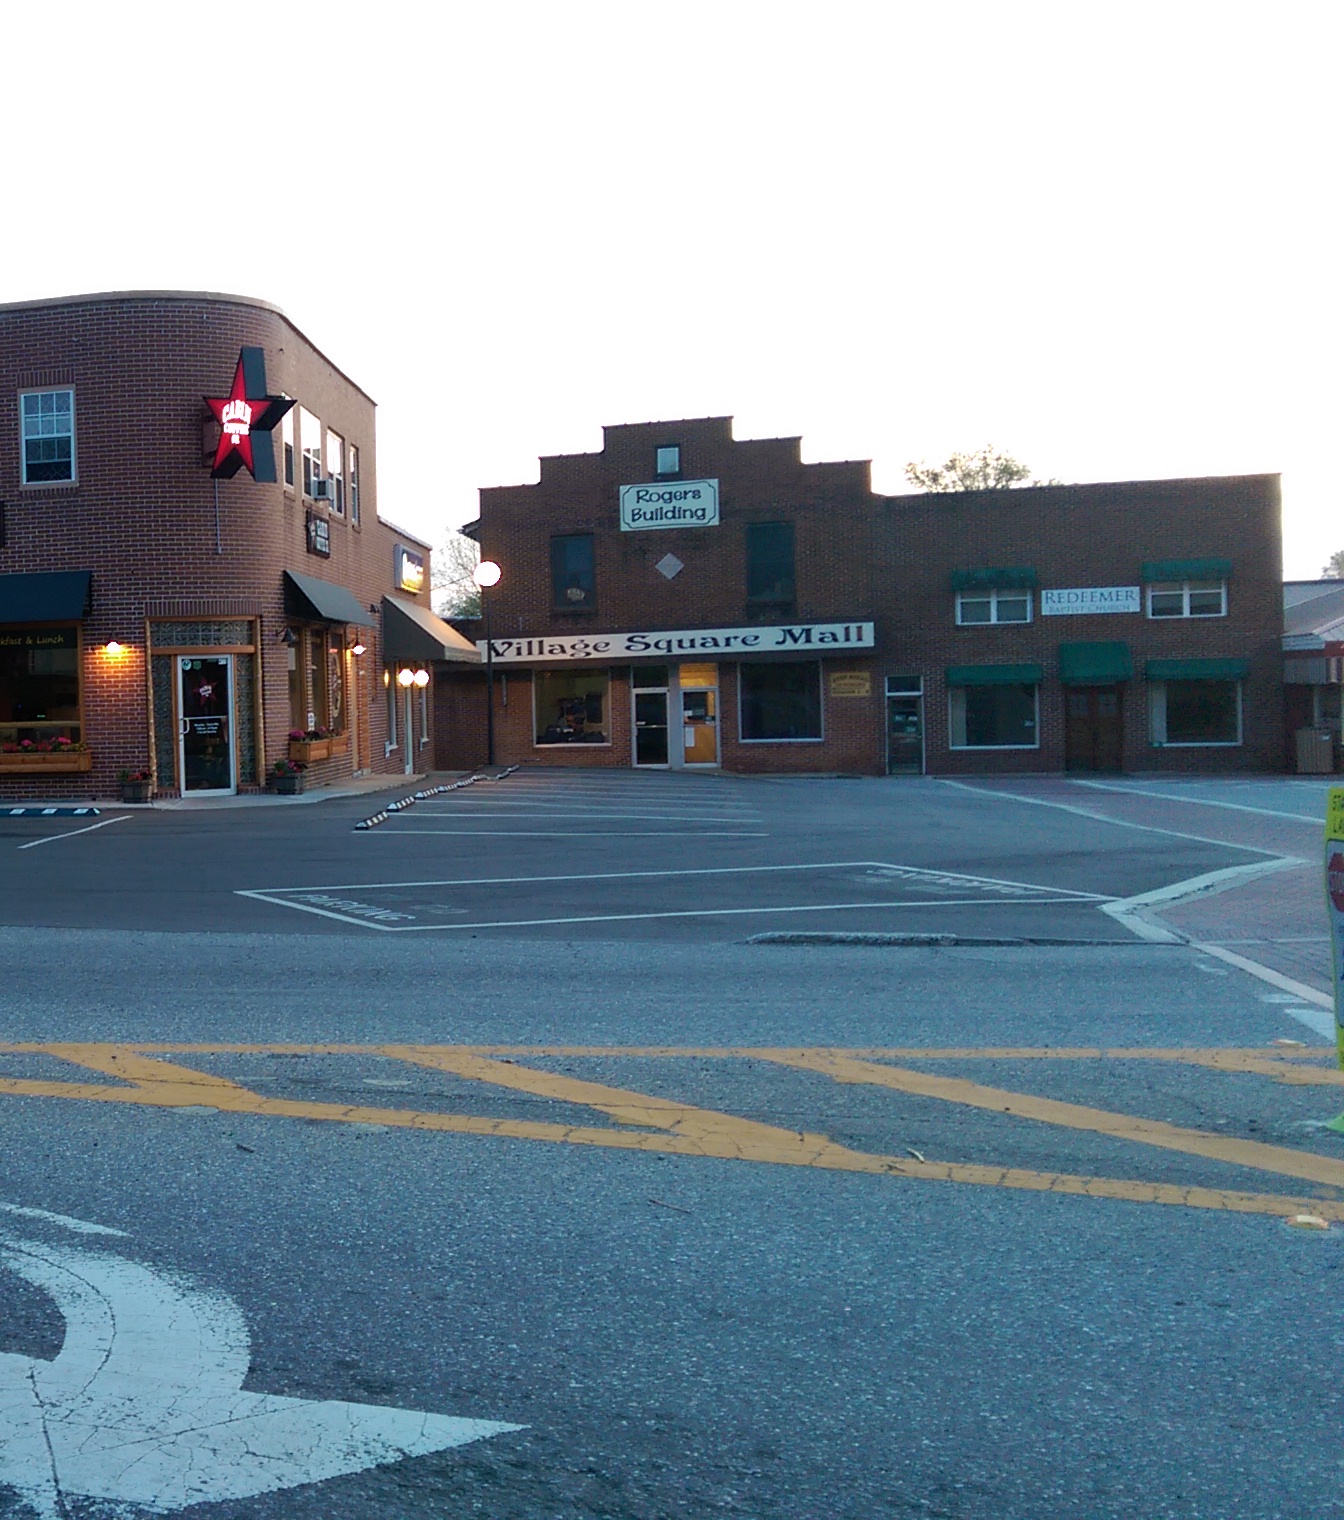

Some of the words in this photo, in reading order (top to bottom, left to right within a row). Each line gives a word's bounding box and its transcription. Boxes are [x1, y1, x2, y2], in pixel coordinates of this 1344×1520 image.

[636, 489, 702, 504] Rogers
[631, 506, 706, 522] Building
[1045, 590, 1136, 604] REDEEMER
[26, 635, 33, 645] &
[37, 634, 64, 645] Lunch
[491, 639, 611, 658] Village
[624, 634, 760, 653] Square
[775, 625, 863, 645] Mall
